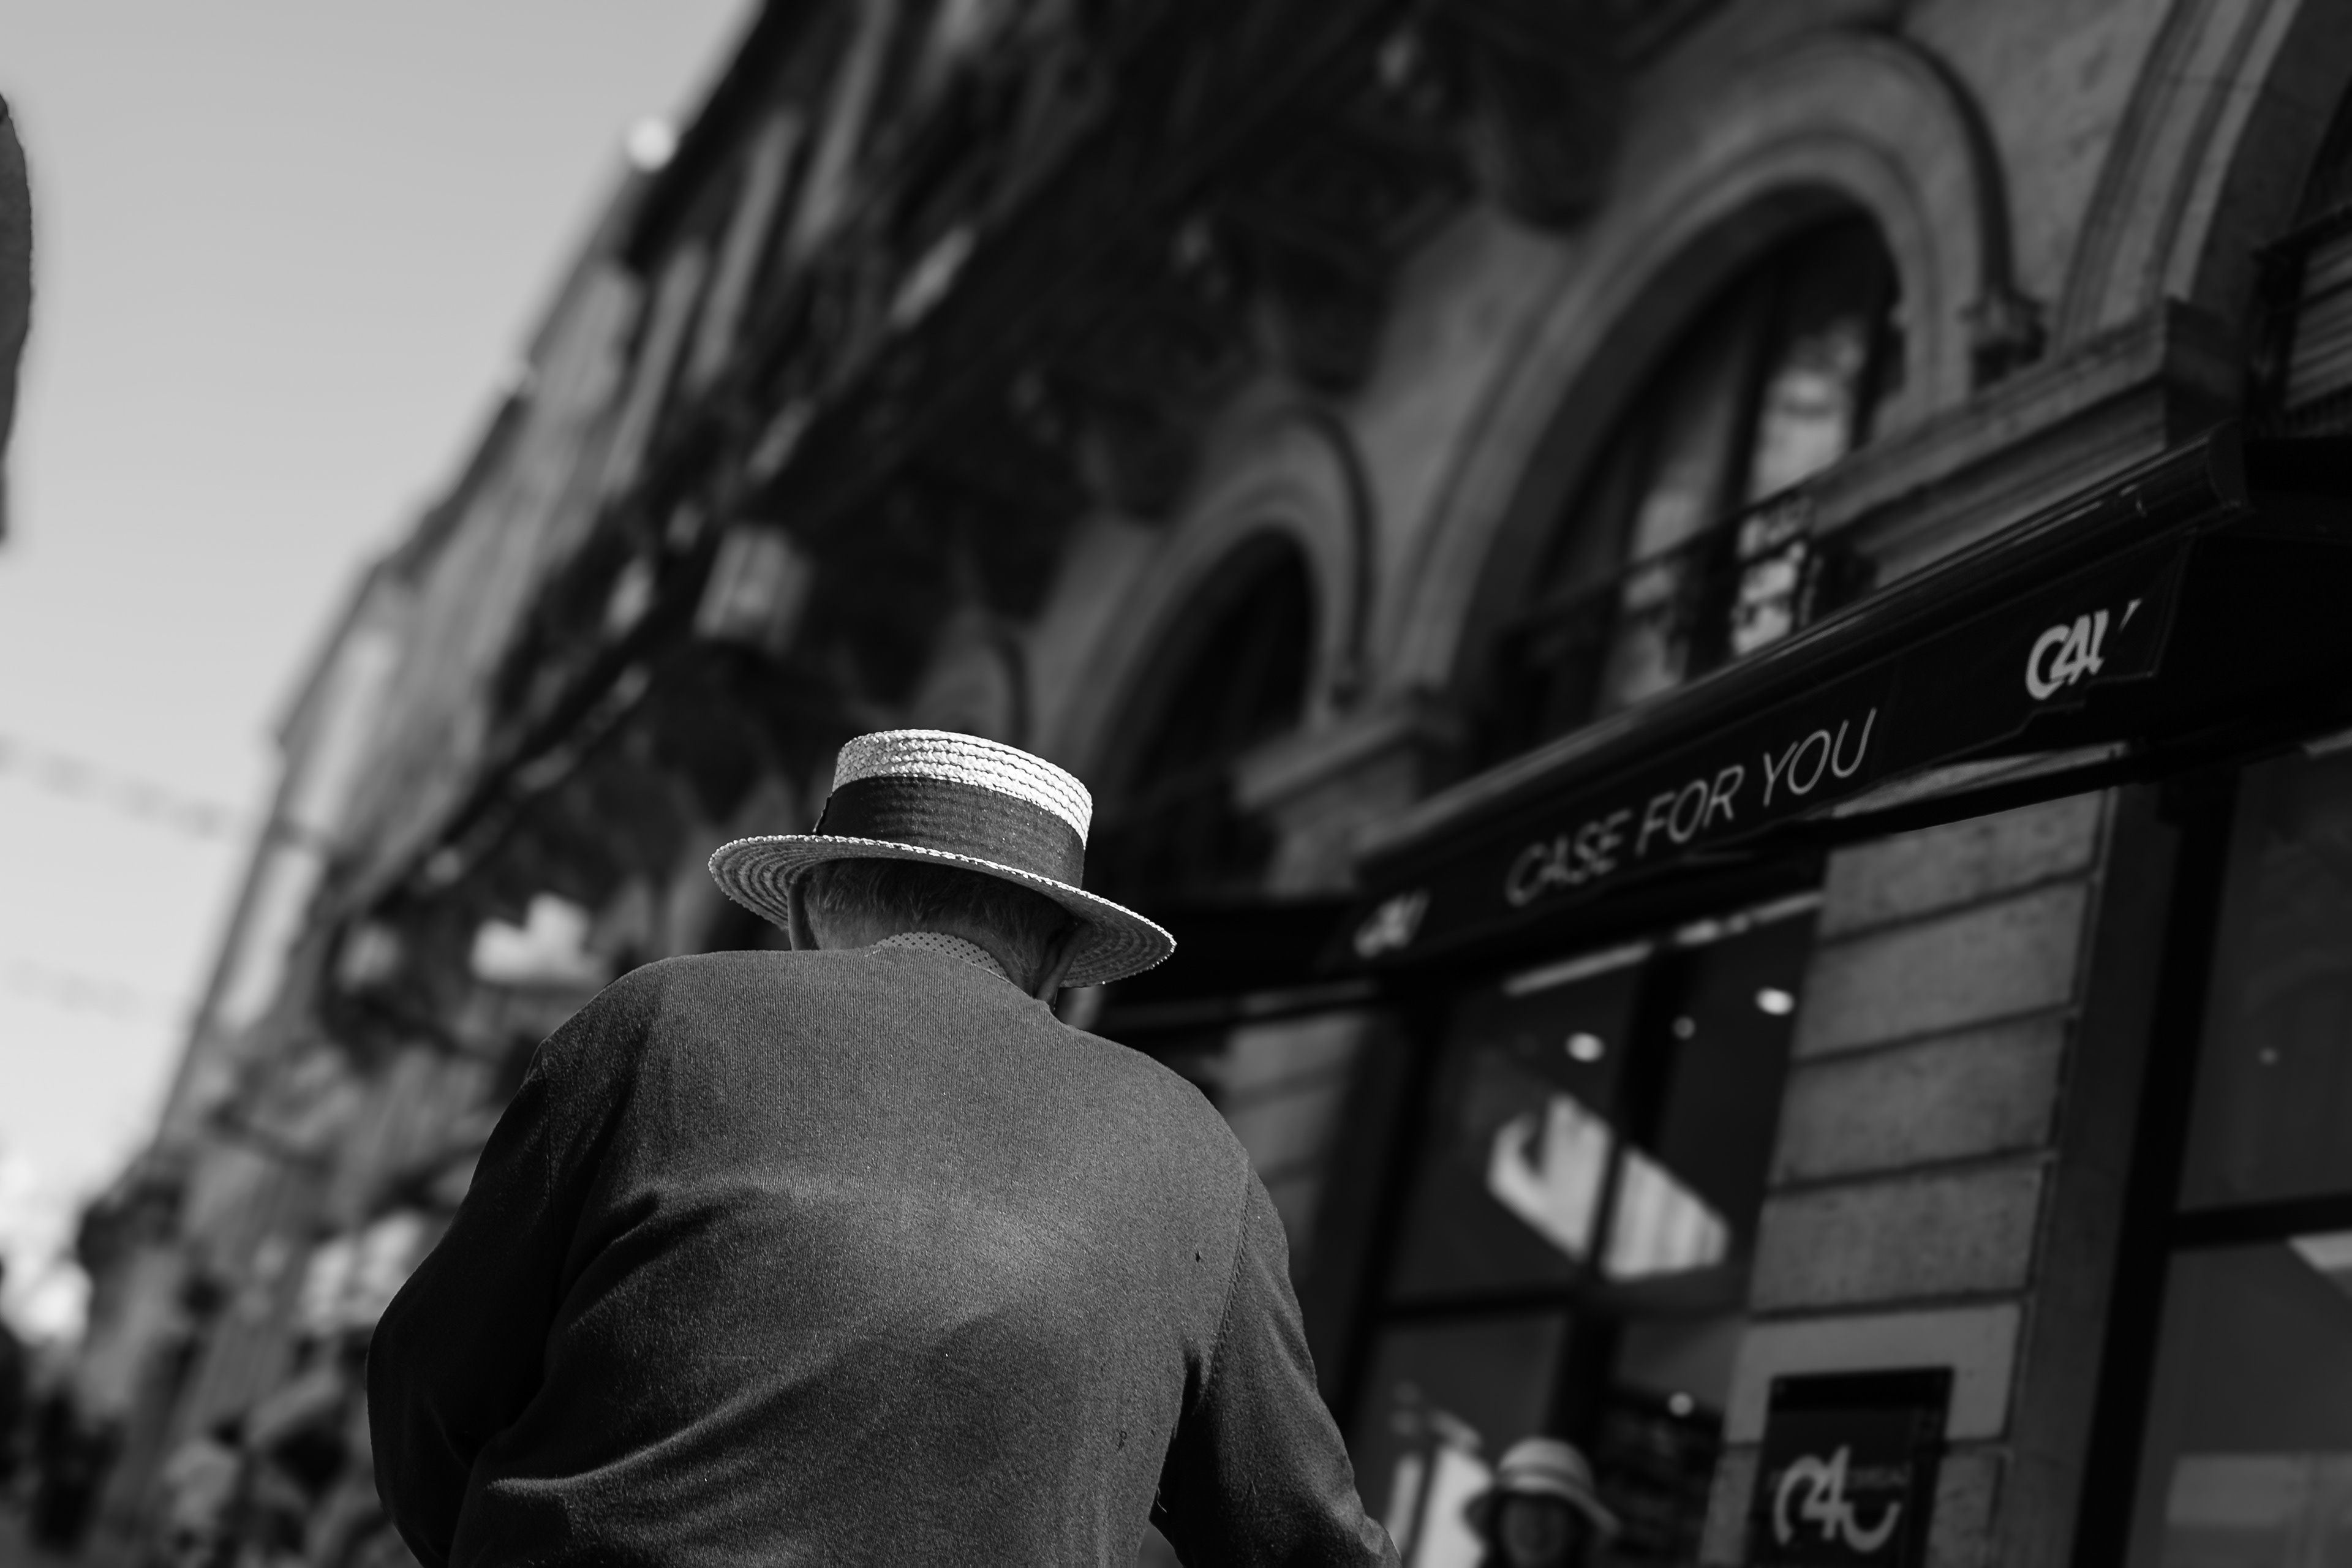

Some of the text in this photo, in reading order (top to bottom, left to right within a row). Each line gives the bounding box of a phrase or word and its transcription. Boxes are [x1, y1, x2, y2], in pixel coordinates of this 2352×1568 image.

[1504, 707, 1877, 907] CASE FOR YOU
